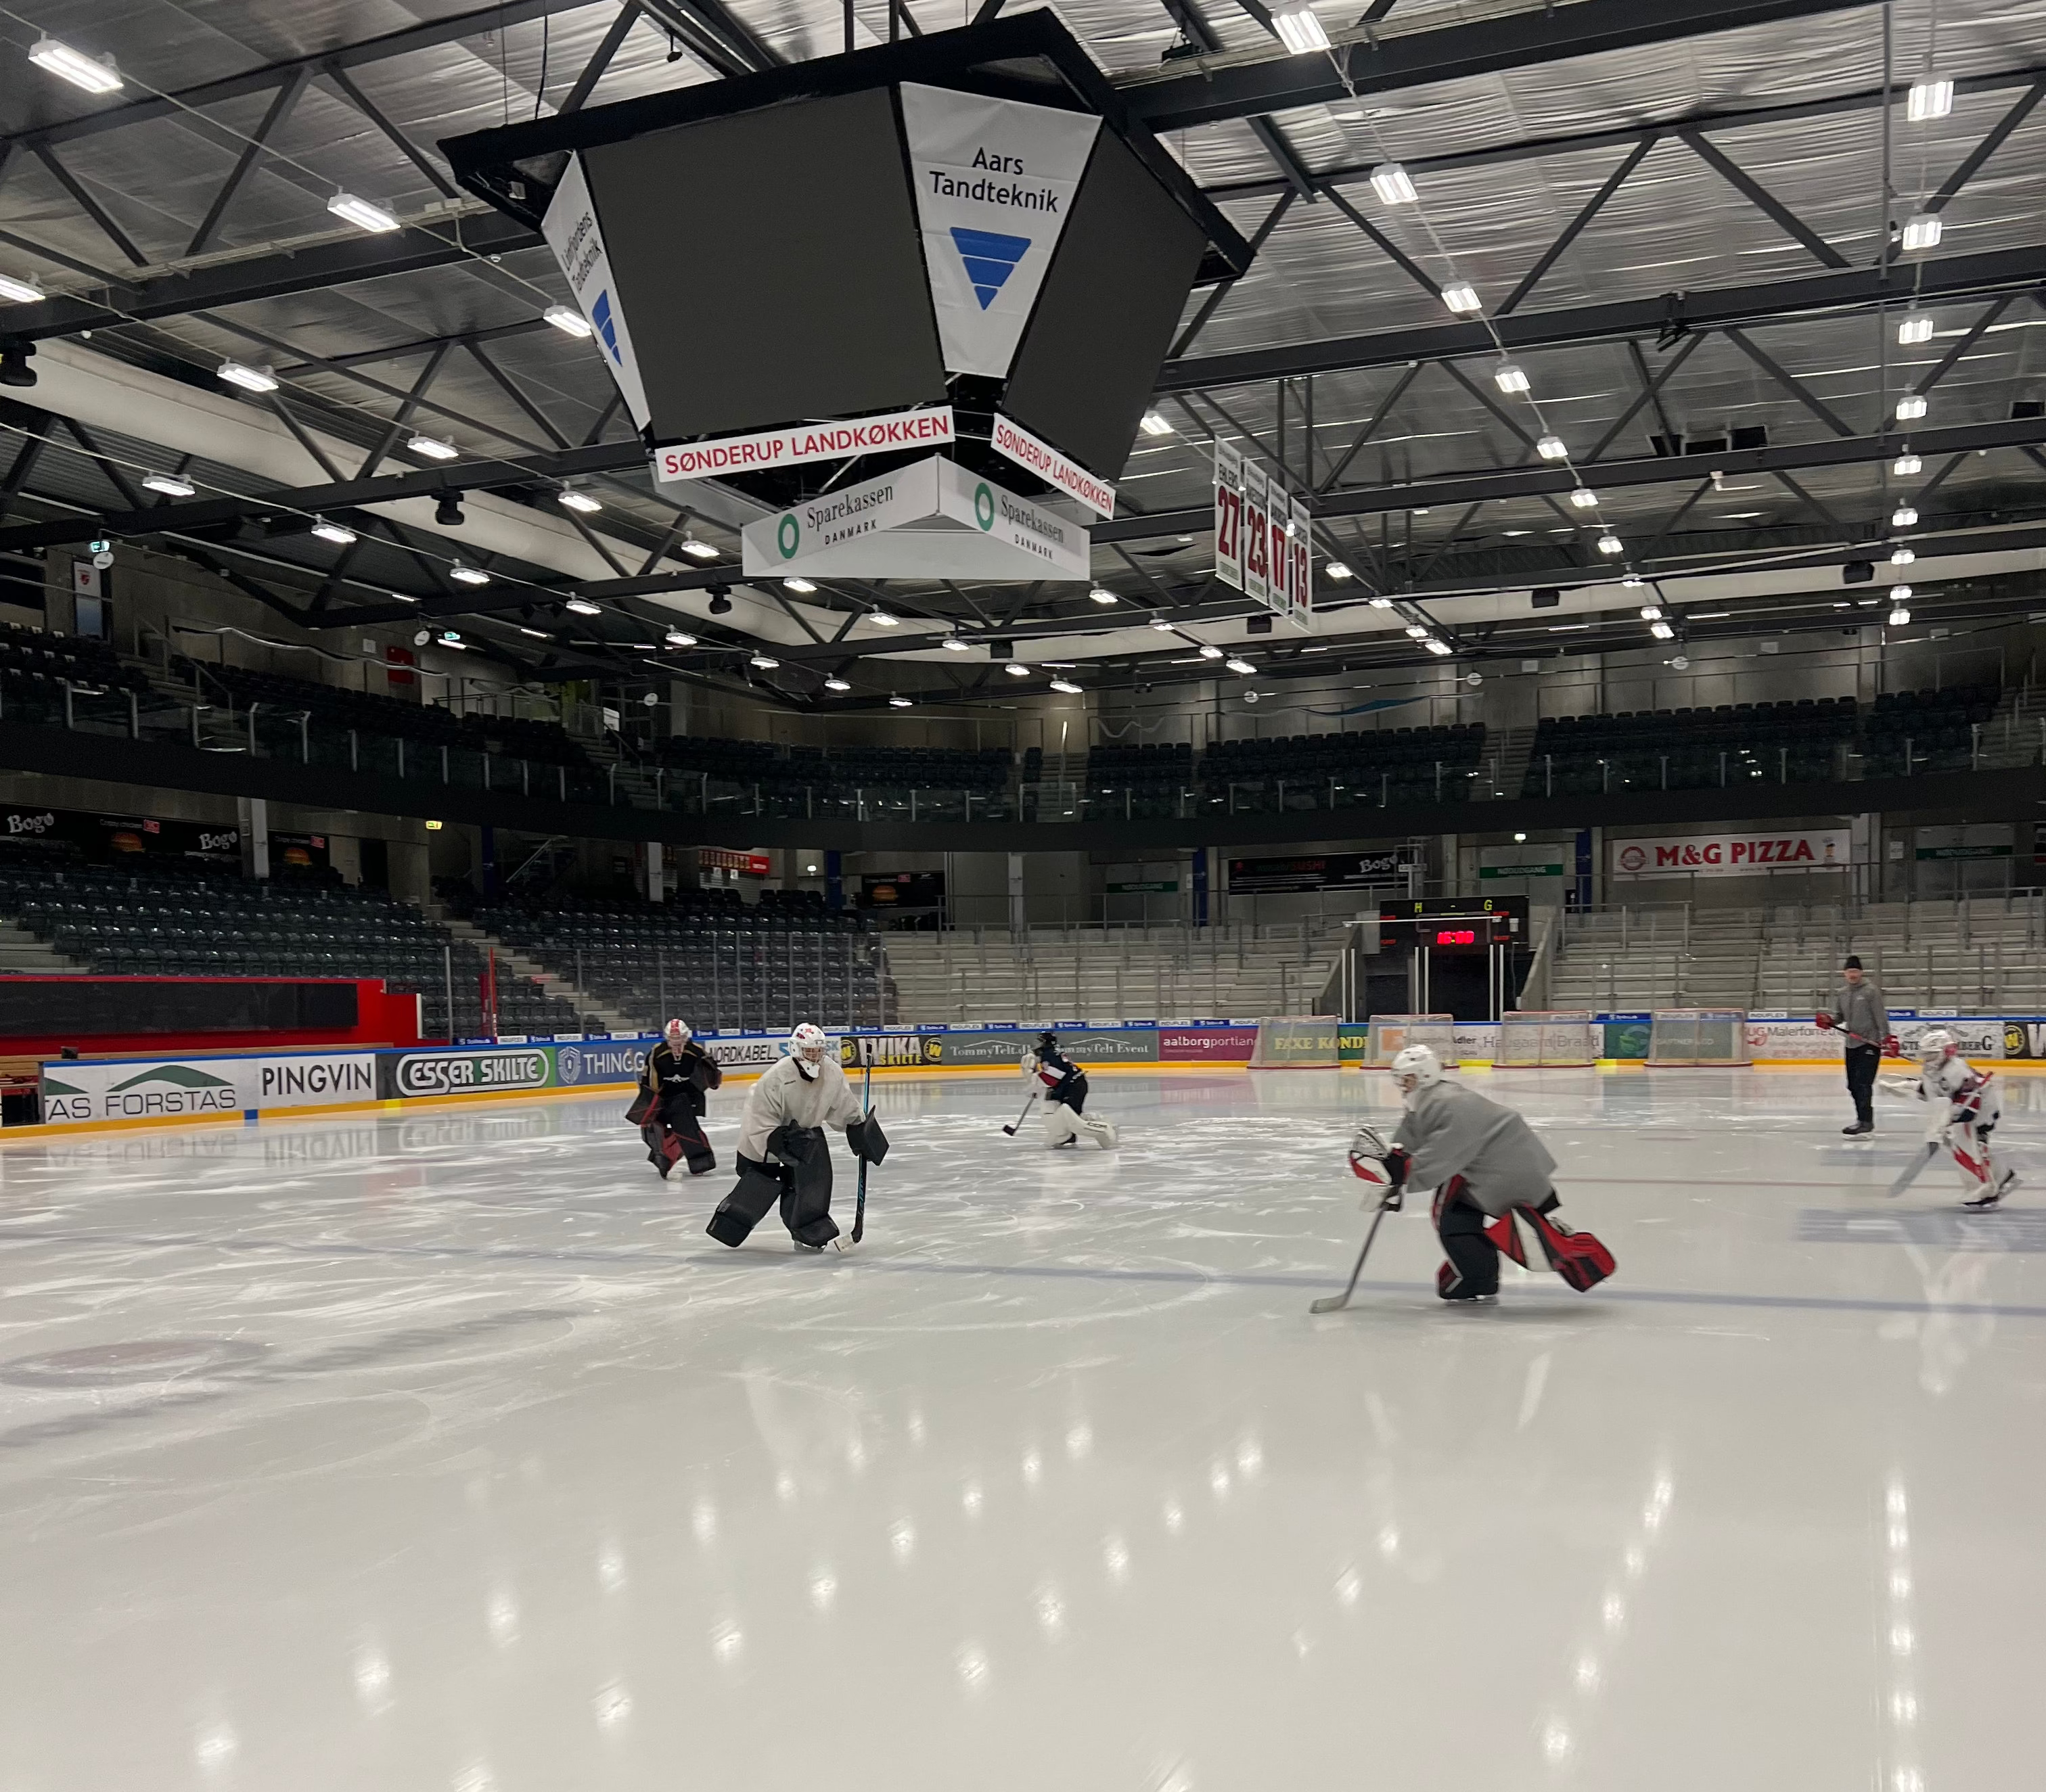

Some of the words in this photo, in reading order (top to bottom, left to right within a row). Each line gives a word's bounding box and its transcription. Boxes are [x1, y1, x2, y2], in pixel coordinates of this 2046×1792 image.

[972, 146, 1024, 175] Aars
[929, 170, 1059, 213] Tandteknik
[664, 439, 784, 474] SØNDERUP
[791, 415, 949, 456] LANDKØKKEN
[996, 423, 1052, 473] SØNDERUP
[1053, 460, 1114, 513] LANDKØKKEN
[806, 485, 893, 532] Sparekassen
[1001, 494, 1064, 544] Sparekassen
[1218, 485, 1240, 561] 27
[824, 519, 878, 545] DANMARK
[1015, 534, 1053, 559] DANMARK
[1247, 505, 1267, 578] 23
[1271, 524, 1286, 591] 17
[1294, 543, 1308, 609] 13
[1655, 843, 1722, 867] M&G
[1731, 839, 1816, 864] PIZZA
[1414, 902, 1423, 913] H
[1484, 899, 1493, 911] G
[710, 1044, 777, 1063] NORDKABEL
[1117, 1044, 1149, 1053] Event
[1275, 1037, 1313, 1049] FAXE
[480, 1056, 539, 1083] SKILTE
[583, 1051, 645, 1074] THINGG
[262, 1062, 372, 1096] PINGVIN
[105, 1089, 236, 1116] FORSTAS
